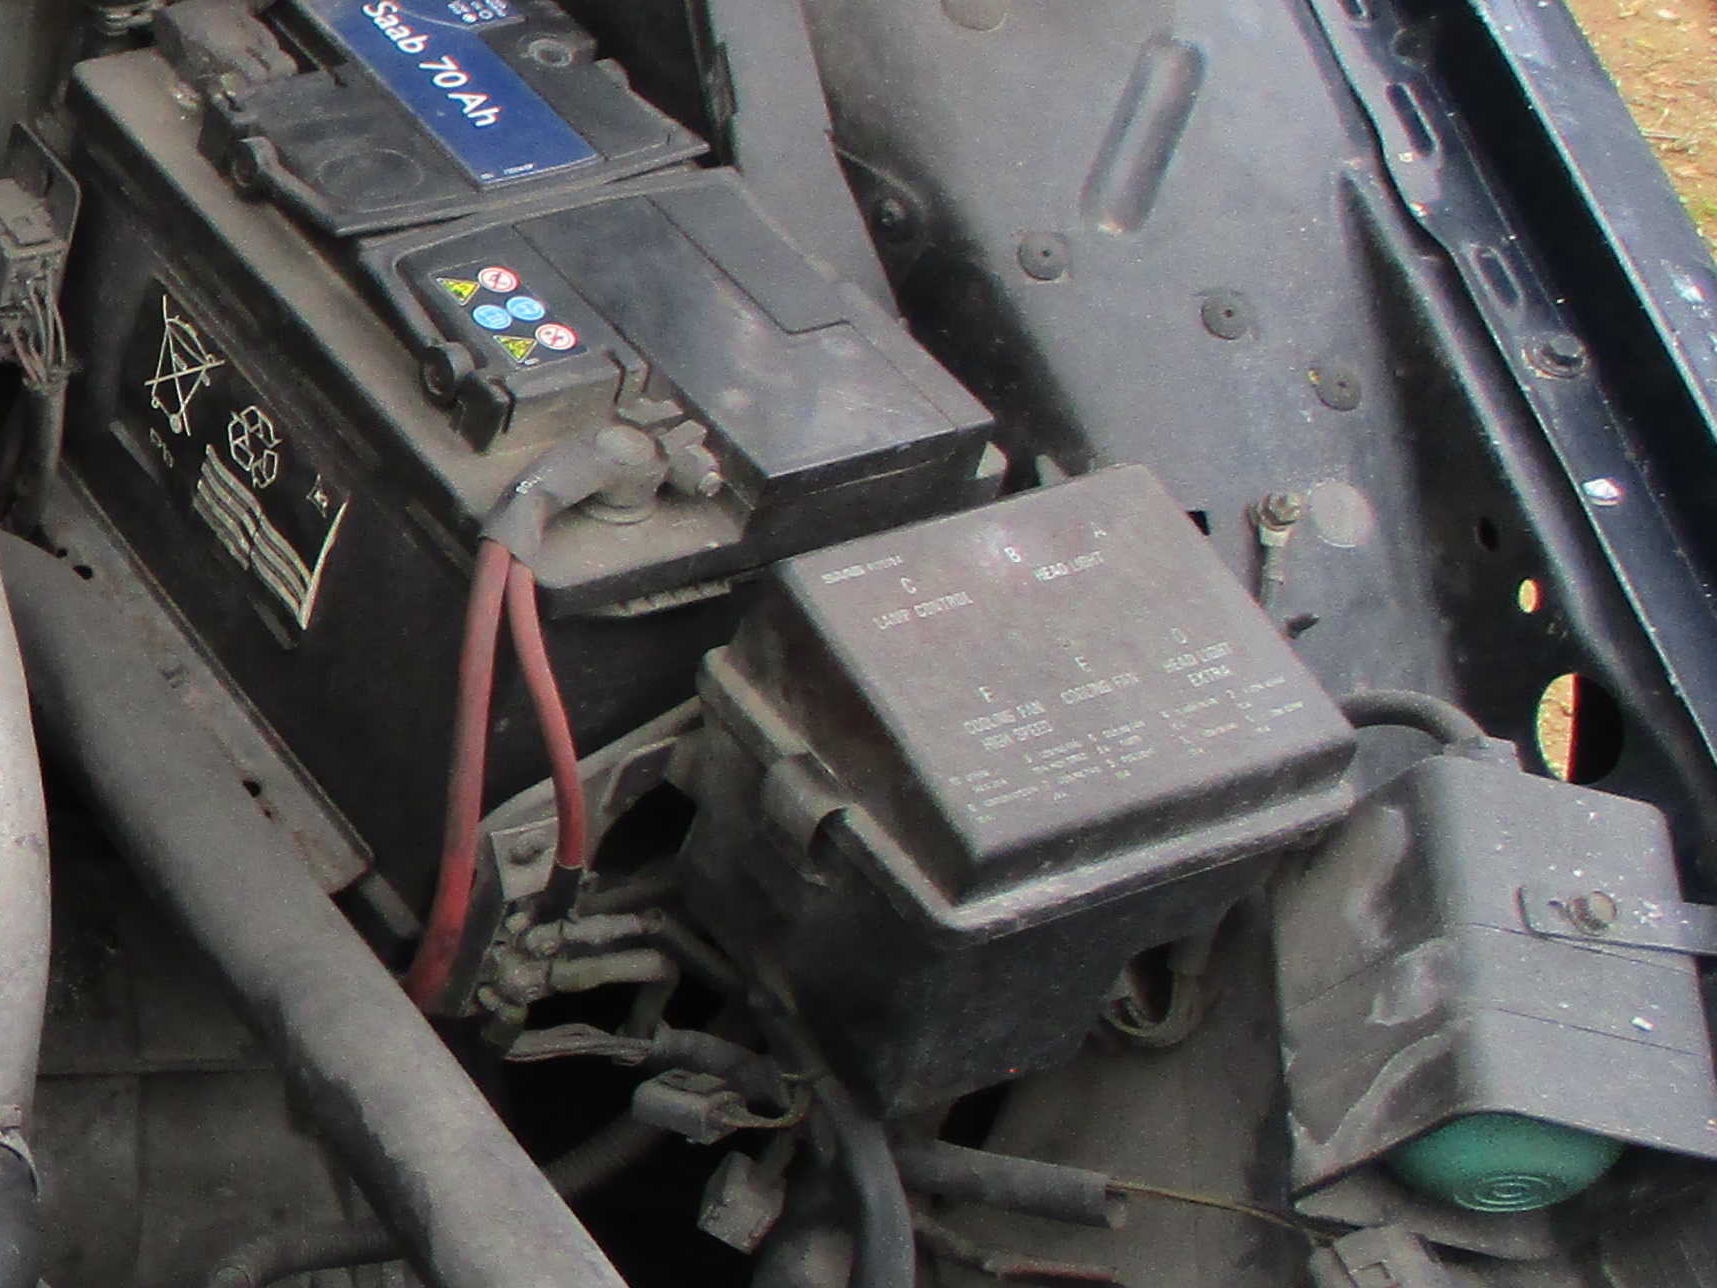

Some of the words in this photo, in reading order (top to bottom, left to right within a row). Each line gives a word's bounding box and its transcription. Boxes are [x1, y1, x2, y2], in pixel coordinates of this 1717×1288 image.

[417, 54, 471, 88] 70
[446, 91, 504, 128] Ah
[899, 575, 918, 595] C
